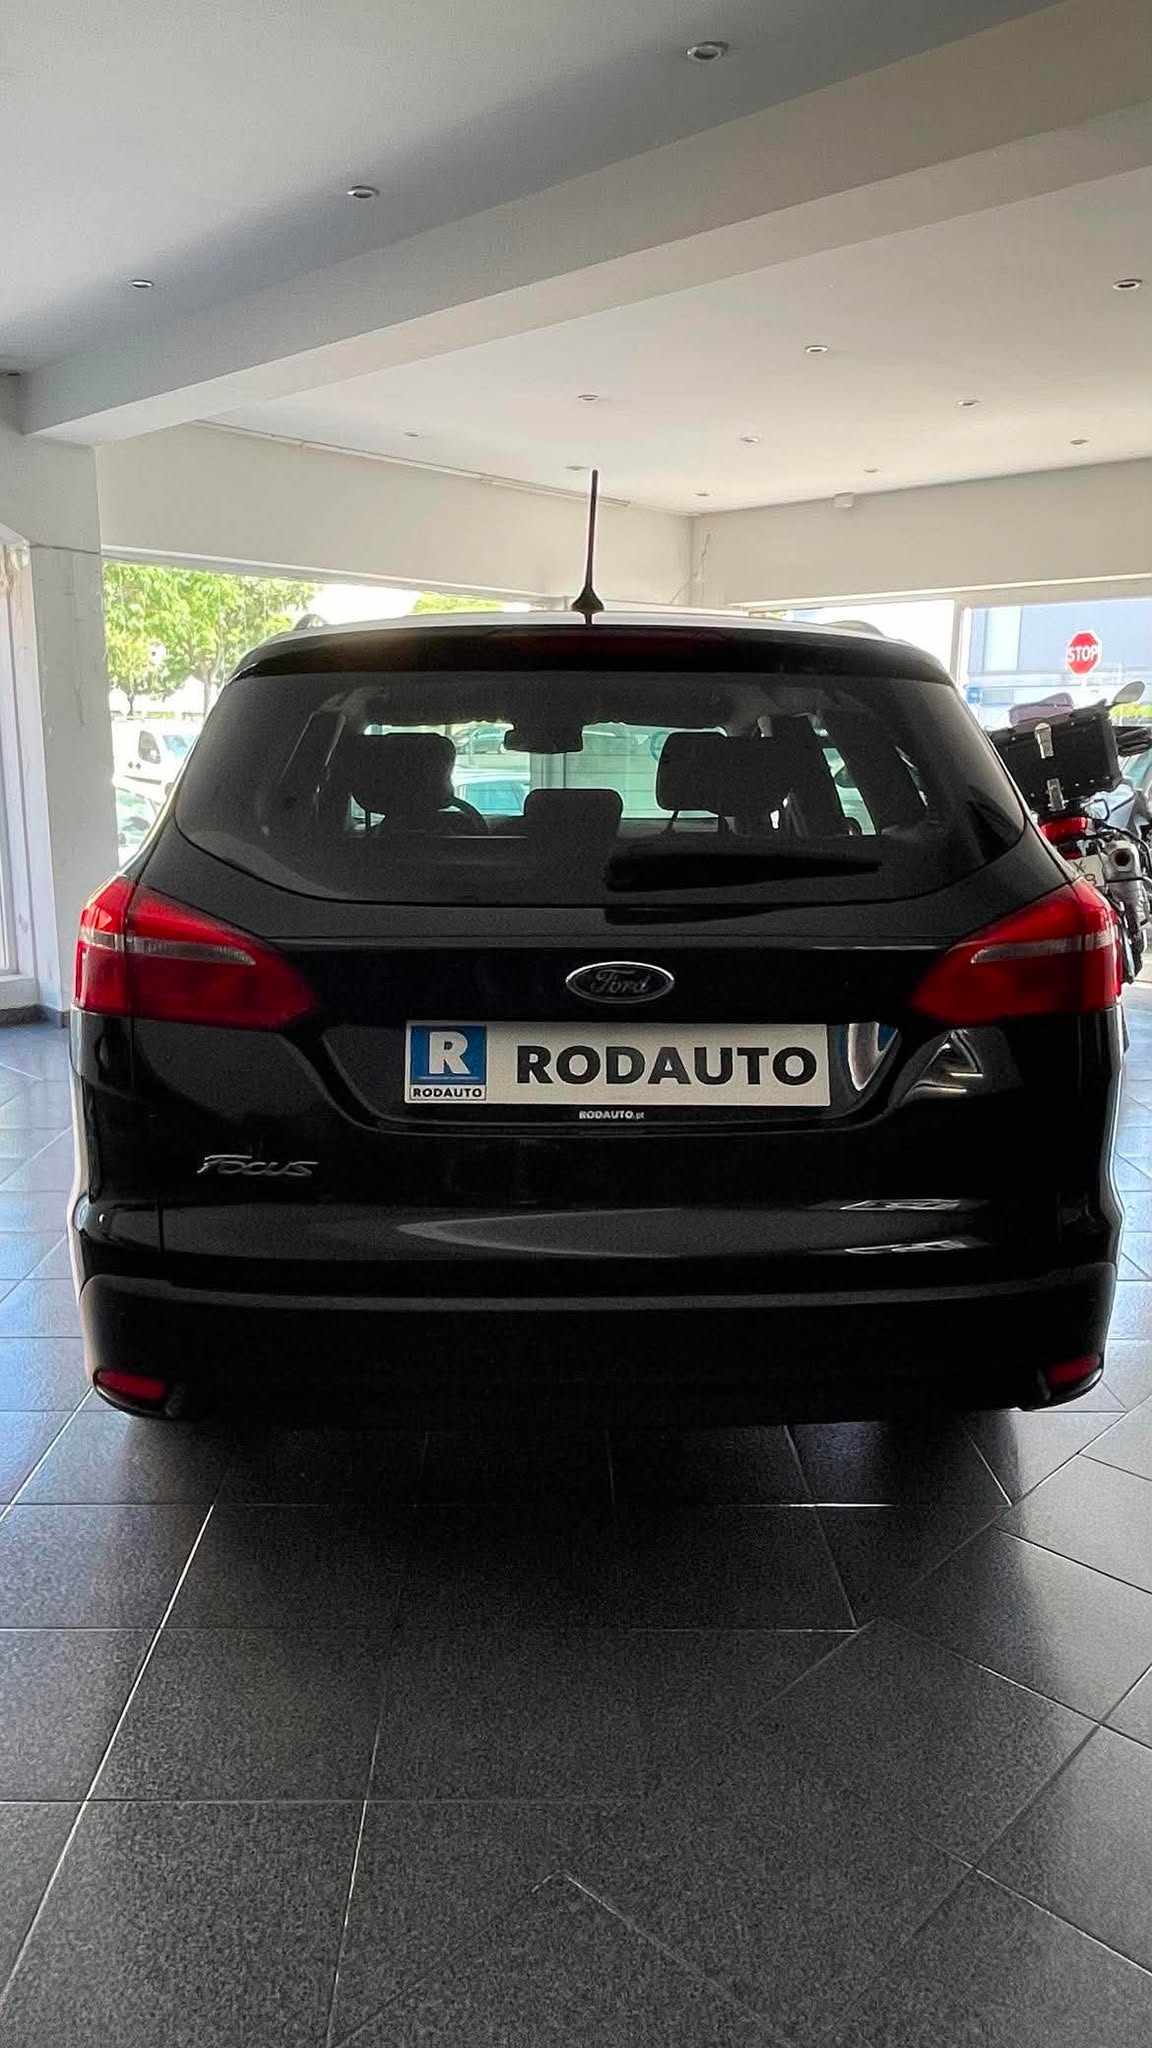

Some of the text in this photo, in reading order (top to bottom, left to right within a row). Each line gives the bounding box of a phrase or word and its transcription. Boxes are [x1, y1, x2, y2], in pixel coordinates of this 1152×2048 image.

[1067, 645, 1098, 661] STOP
[590, 969, 651, 993] Ford
[428, 1031, 471, 1075] R
[516, 1045, 818, 1086] RODAUTO
[412, 1088, 482, 1099] RODAUTO
